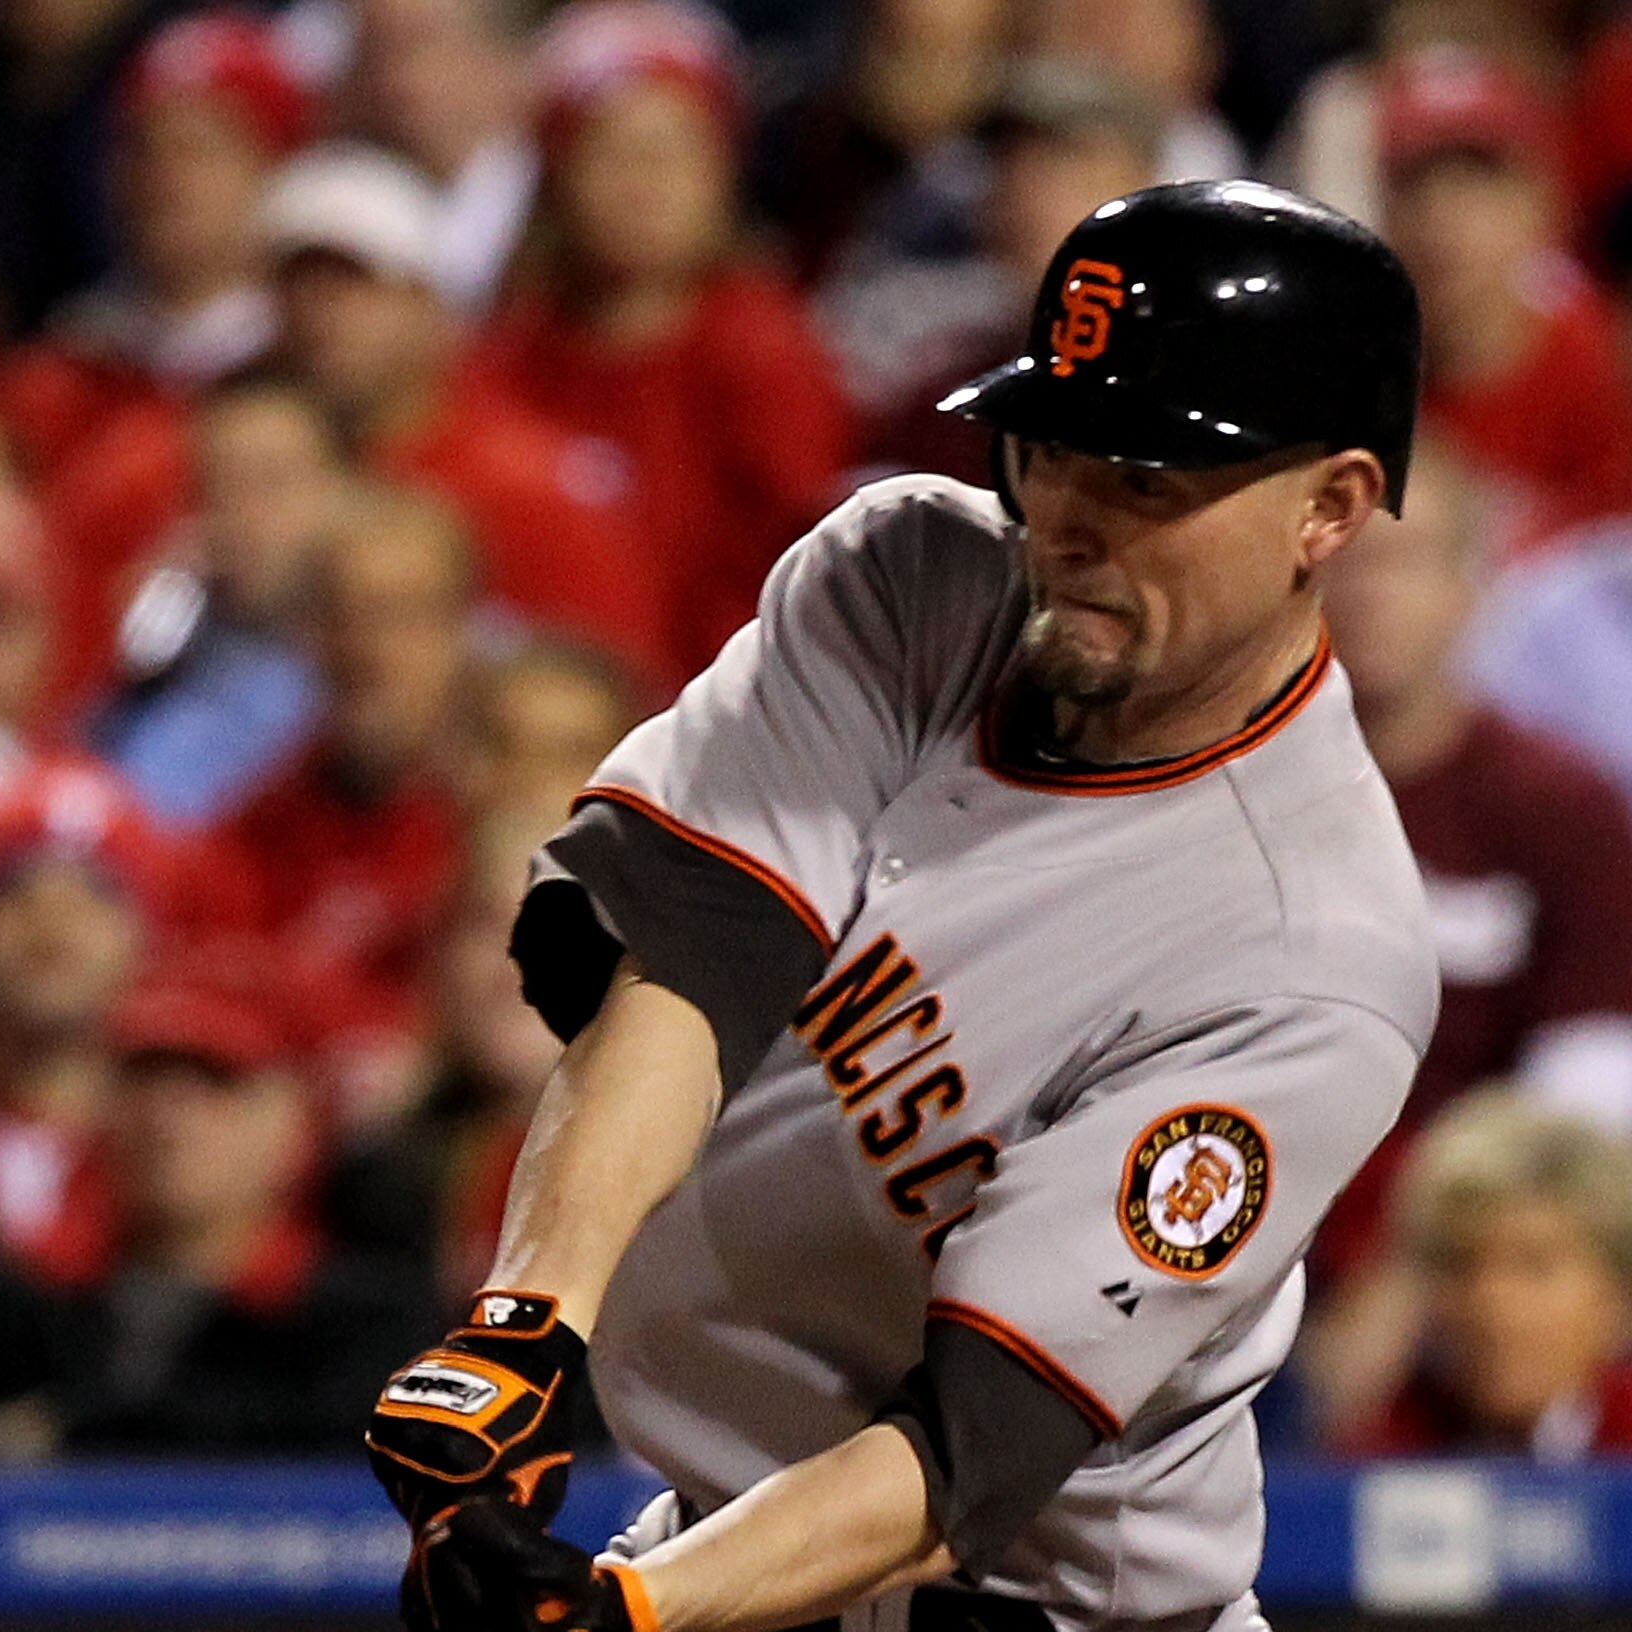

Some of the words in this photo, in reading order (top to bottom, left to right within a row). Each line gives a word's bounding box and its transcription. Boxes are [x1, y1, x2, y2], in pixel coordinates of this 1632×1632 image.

[1138, 1117, 1190, 1171] SAN
[1199, 1113, 1265, 1243] FRANCISCO
[1128, 1200, 1207, 1270] GIANTS
